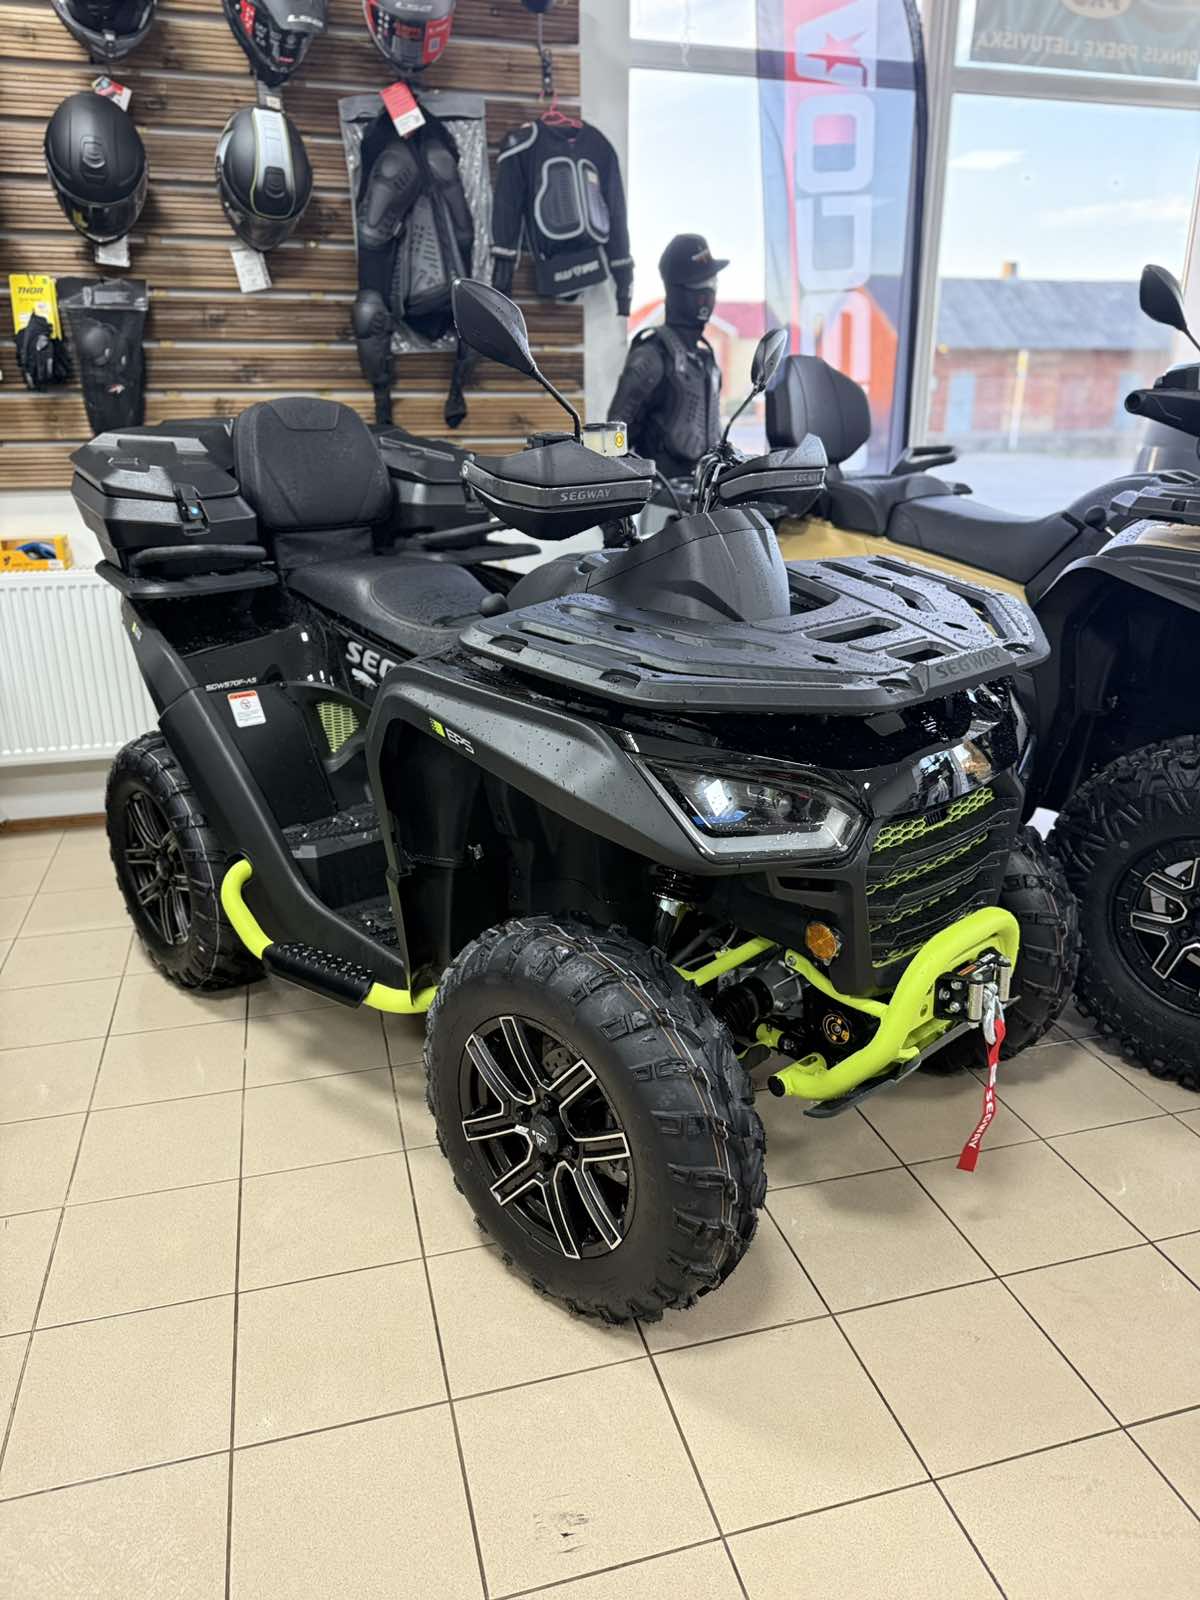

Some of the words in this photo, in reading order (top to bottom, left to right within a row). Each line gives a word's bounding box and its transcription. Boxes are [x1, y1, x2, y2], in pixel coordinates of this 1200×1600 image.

[17, 286, 44, 295] THOR
[560, 488, 612, 502] SEGWAY
[935, 649, 1001, 679] SEGWAY
[444, 727, 475, 755] EPS
[969, 1089, 995, 1149] SEGWAY
